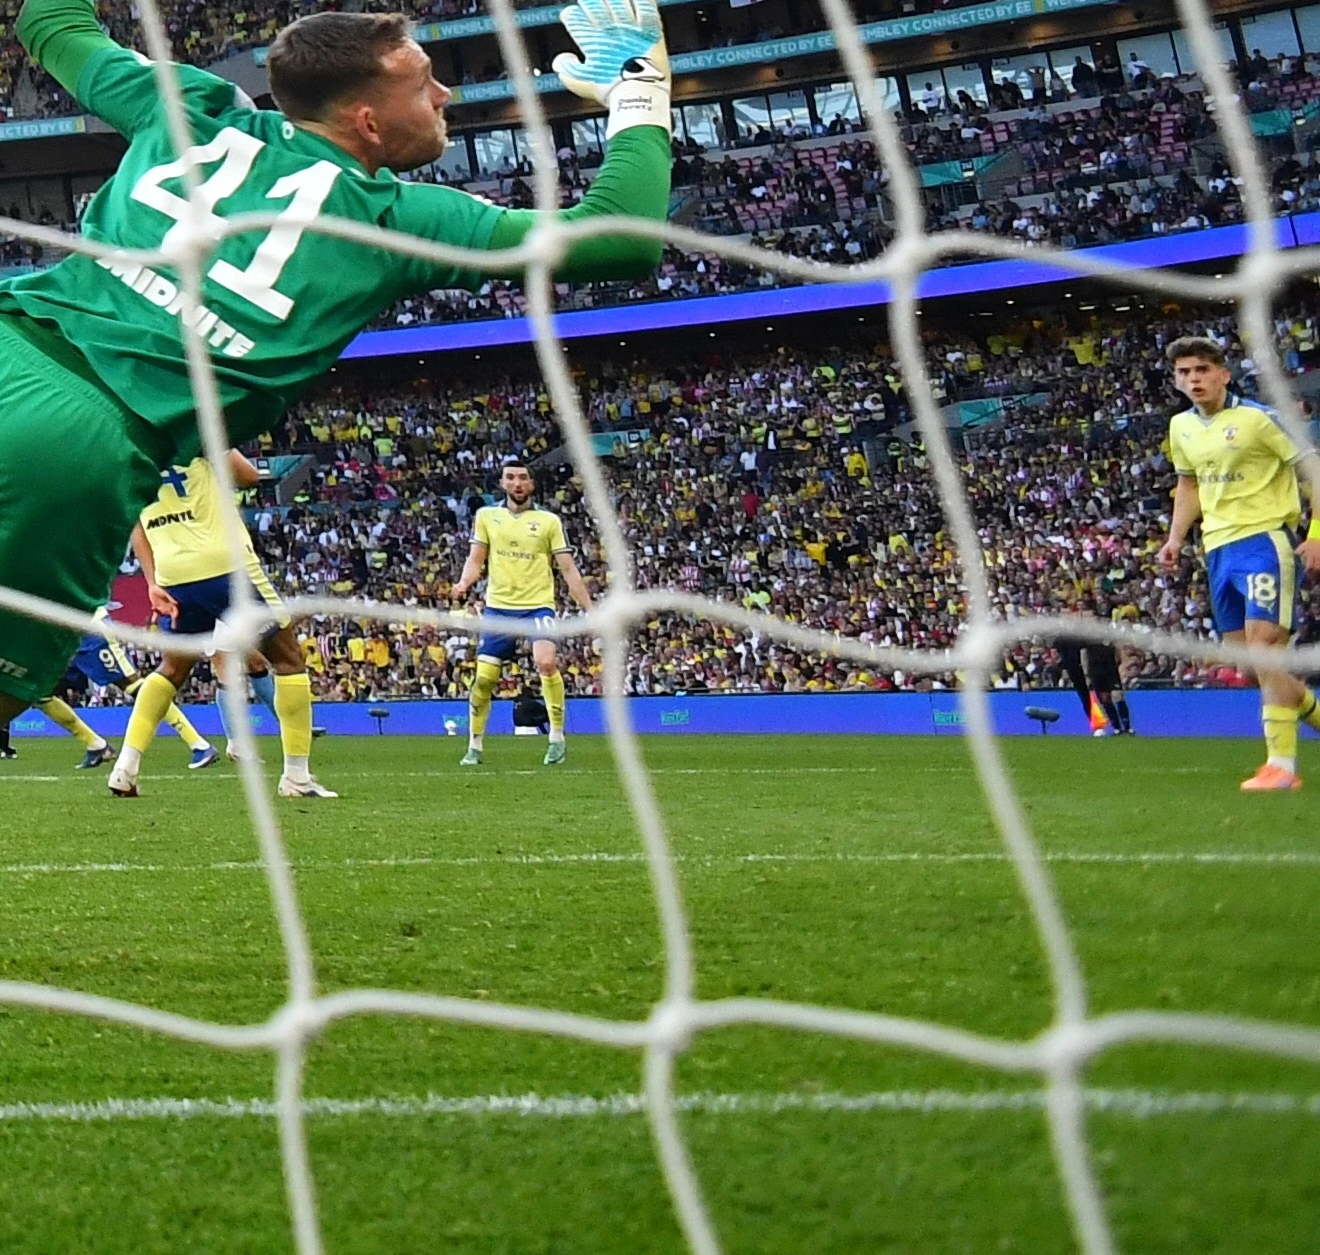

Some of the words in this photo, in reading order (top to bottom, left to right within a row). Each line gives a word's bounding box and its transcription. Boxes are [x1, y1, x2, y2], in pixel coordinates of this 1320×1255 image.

[860, 22, 909, 41] EMBLEY
[912, 7, 995, 31] CONNECTED
[996, 4, 1013, 18] BY
[1016, 1, 1031, 14] EE
[672, 54, 714, 70] MBLEY
[717, 42, 797, 63] CONNECTED
[799, 39, 816, 52] BY
[819, 36, 833, 49] EE
[130, 126, 344, 321] 41
[1247, 573, 1277, 601] 18
